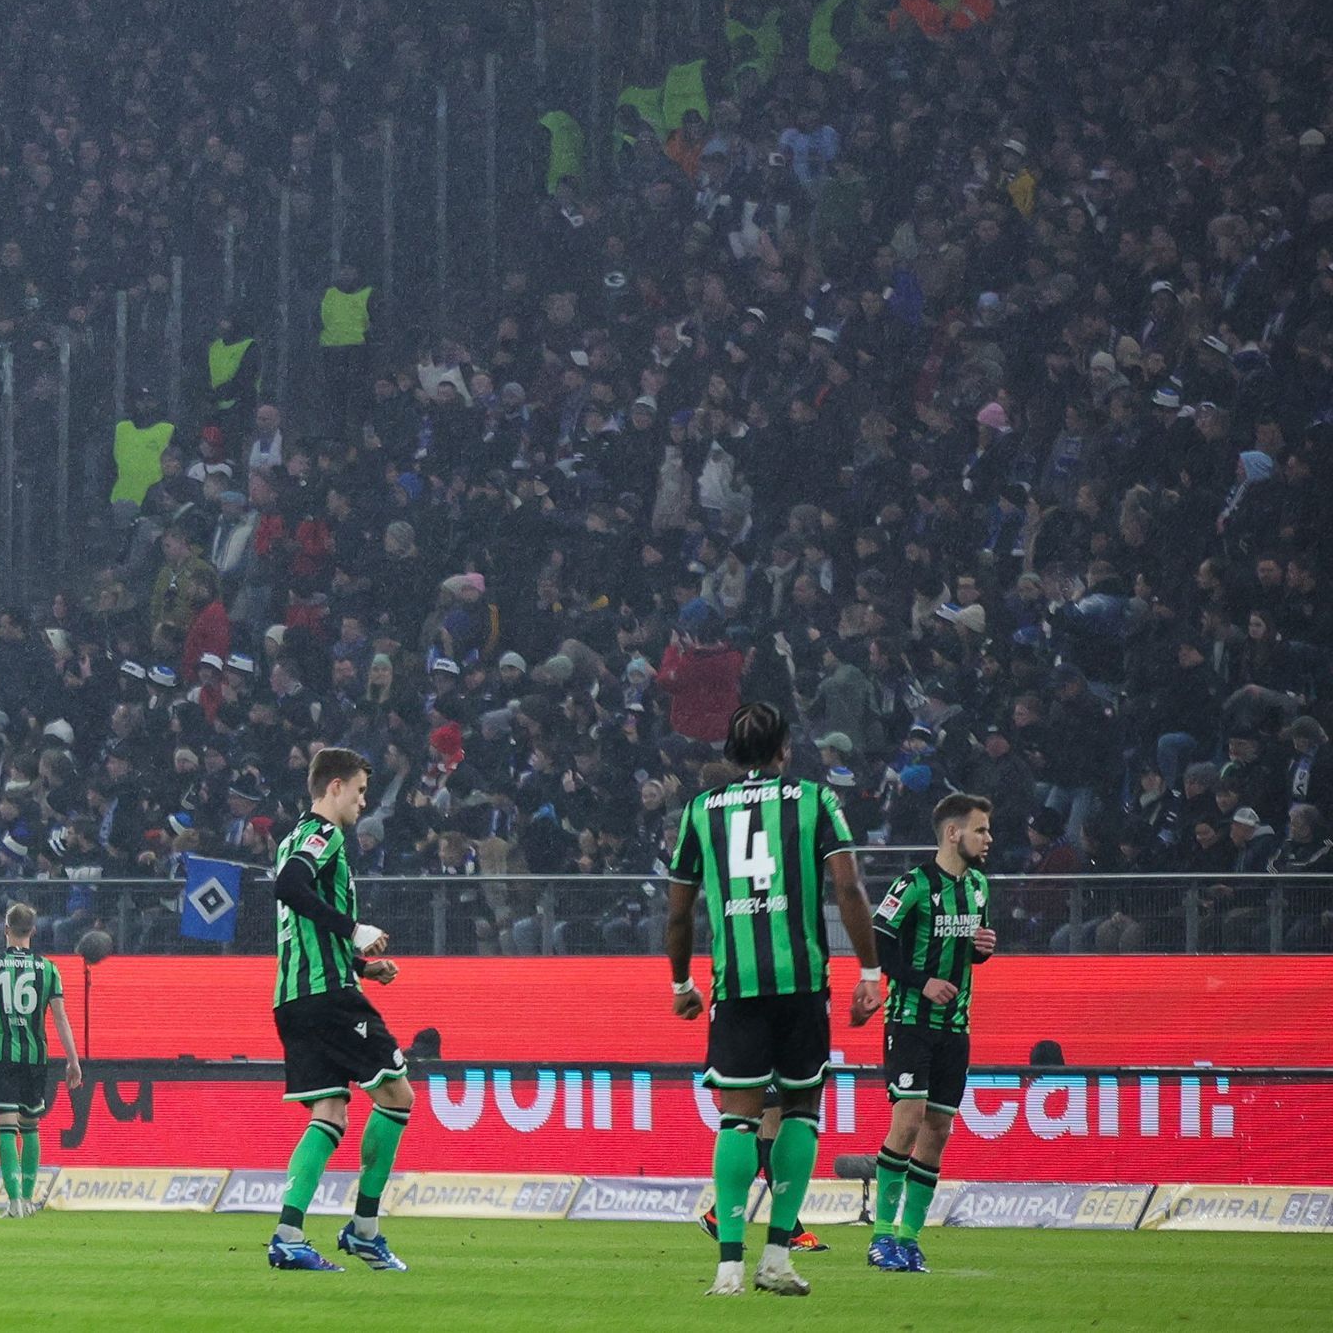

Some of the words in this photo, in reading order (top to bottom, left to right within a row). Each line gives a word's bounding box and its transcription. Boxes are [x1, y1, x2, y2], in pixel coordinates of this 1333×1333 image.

[703, 785, 781, 810] HANNOVER
[781, 784, 803, 800] 96
[728, 809, 777, 891] 4
[35, 961, 45, 970] 96
[52, 1178, 157, 1201] ADMIRAL
[165, 1175, 219, 1202] BET
[223, 1176, 340, 1205] ADMAL
[401, 1180, 511, 1208] ADMIRAL
[516, 1180, 571, 1209] BET
[575, 1184, 691, 1213] ADMIRAL
[957, 1184, 1076, 1218] ADMIRAL
[1082, 1187, 1139, 1223] BET
